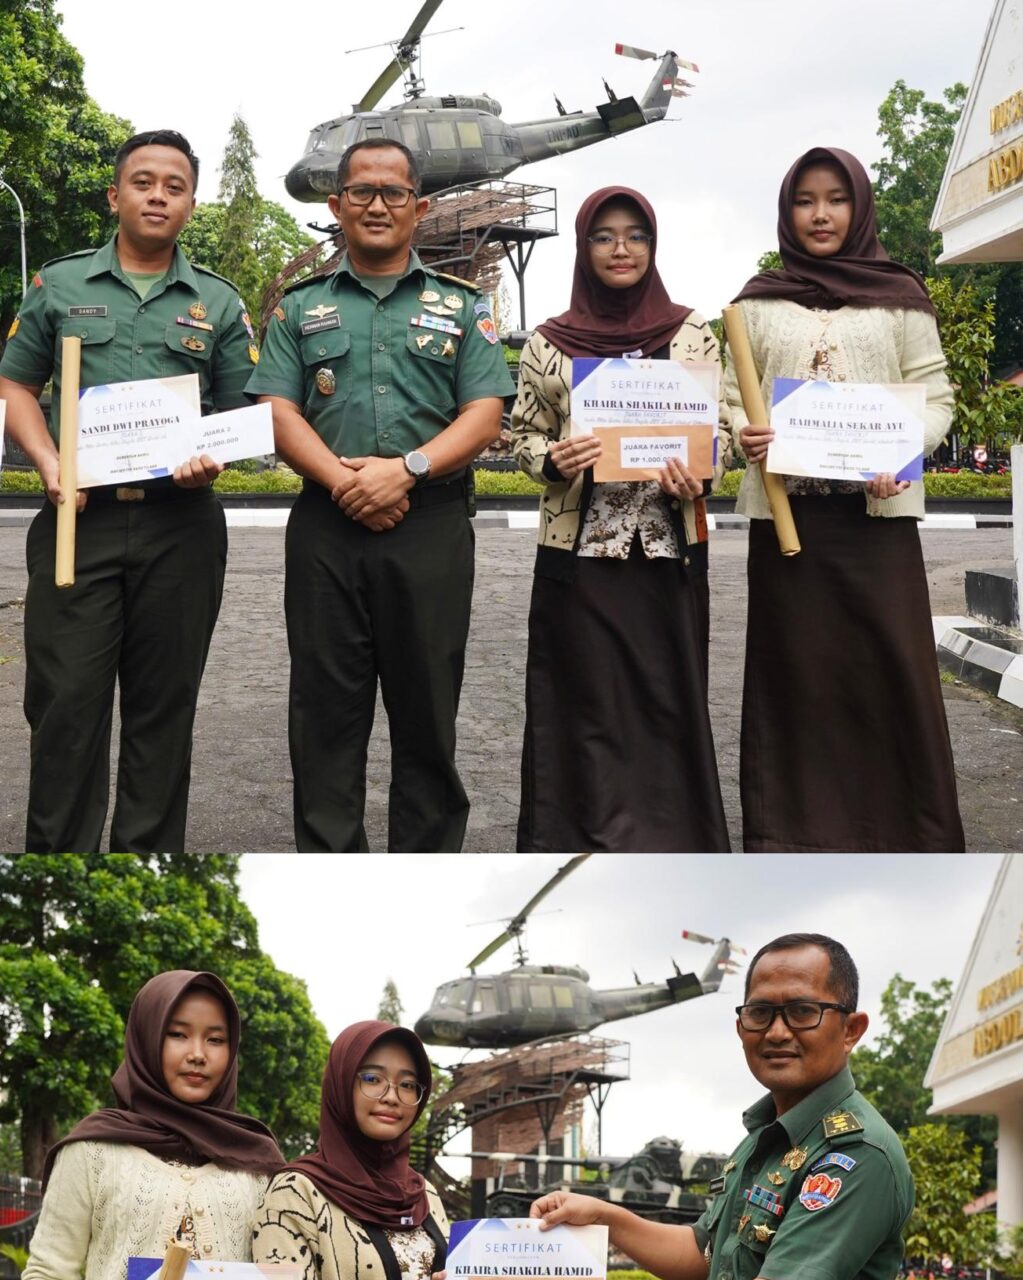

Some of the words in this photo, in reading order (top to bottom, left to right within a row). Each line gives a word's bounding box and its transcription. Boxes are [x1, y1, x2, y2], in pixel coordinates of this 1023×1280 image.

[611, 380, 681, 390] SERTIFIKAT
[95, 398, 163, 414] SERTIFIKAT
[584, 400, 623, 408] KHAIRA
[626, 401, 670, 410] SHAKILA
[674, 402, 707, 411] HAMID
[812, 401, 885, 411] SERTIFIKAT
[81, 426, 110, 435] SANDI
[113, 422, 132, 432] DWI
[135, 415, 180, 429] PRAYOGA
[789, 418, 843, 429] RAHMALIA
[847, 421, 881, 430] SEKAR
[485, 1243, 562, 1252] SERTIFIKAT
[455, 1266, 498, 1275] KHAIRA
[502, 1266, 551, 1275] SHAKILA
[554, 1266, 593, 1276] HAMID
